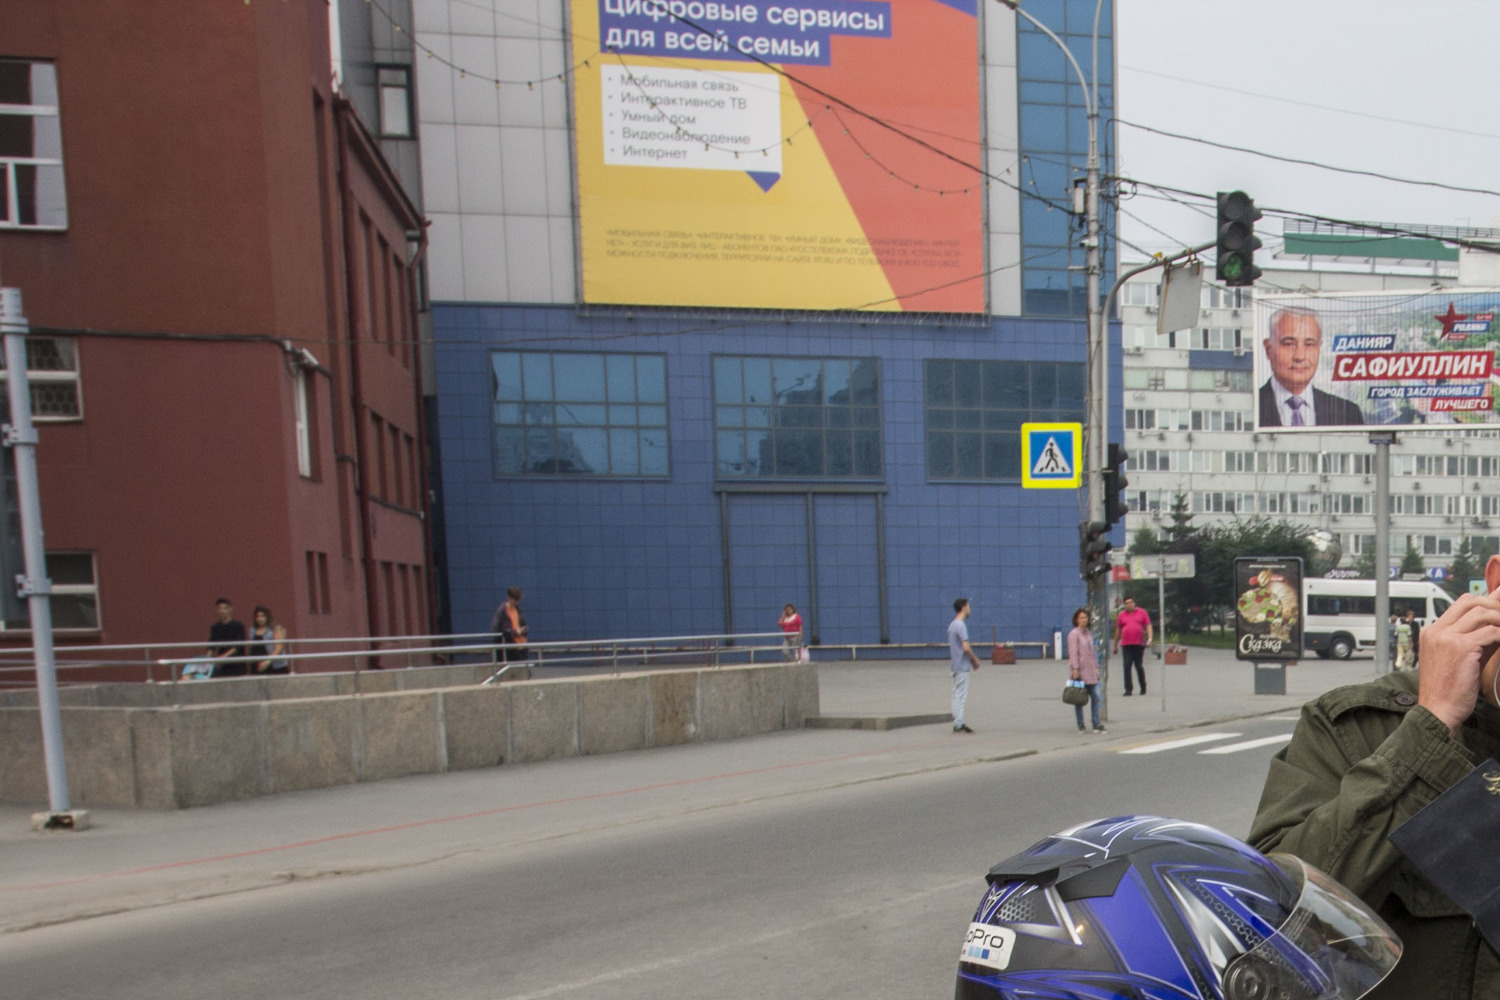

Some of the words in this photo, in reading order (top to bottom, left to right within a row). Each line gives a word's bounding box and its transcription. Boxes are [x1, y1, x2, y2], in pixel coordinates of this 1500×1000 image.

[604, 0, 758, 23] Цифровые
[766, 5, 884, 31] сервисы
[605, 28, 656, 49] для
[664, 29, 729, 53] всей
[737, 37, 820, 58] семьи
[620, 74, 698, 89] Мобильная
[701, 80, 739, 92] связь
[620, 92, 726, 109] Интерактивное
[731, 97, 748, 110] ТВ
[621, 109, 664, 124] Умный
[669, 113, 697, 125] дом
[621, 127, 751, 145] Видеонаблюдение
[622, 145, 687, 160] Интернет
[1334, 336, 1393, 351] ДАНИЯР
[1337, 354, 1488, 379] САФИУЛЛИН
[1370, 386, 1405, 399] ГОРОД
[1406, 384, 1483, 398] ЗАСЛУЖИВАЕТ
[1434, 399, 1489, 411] ЛУЧШЕГО
[1239, 633, 1283, 654] Сказка
